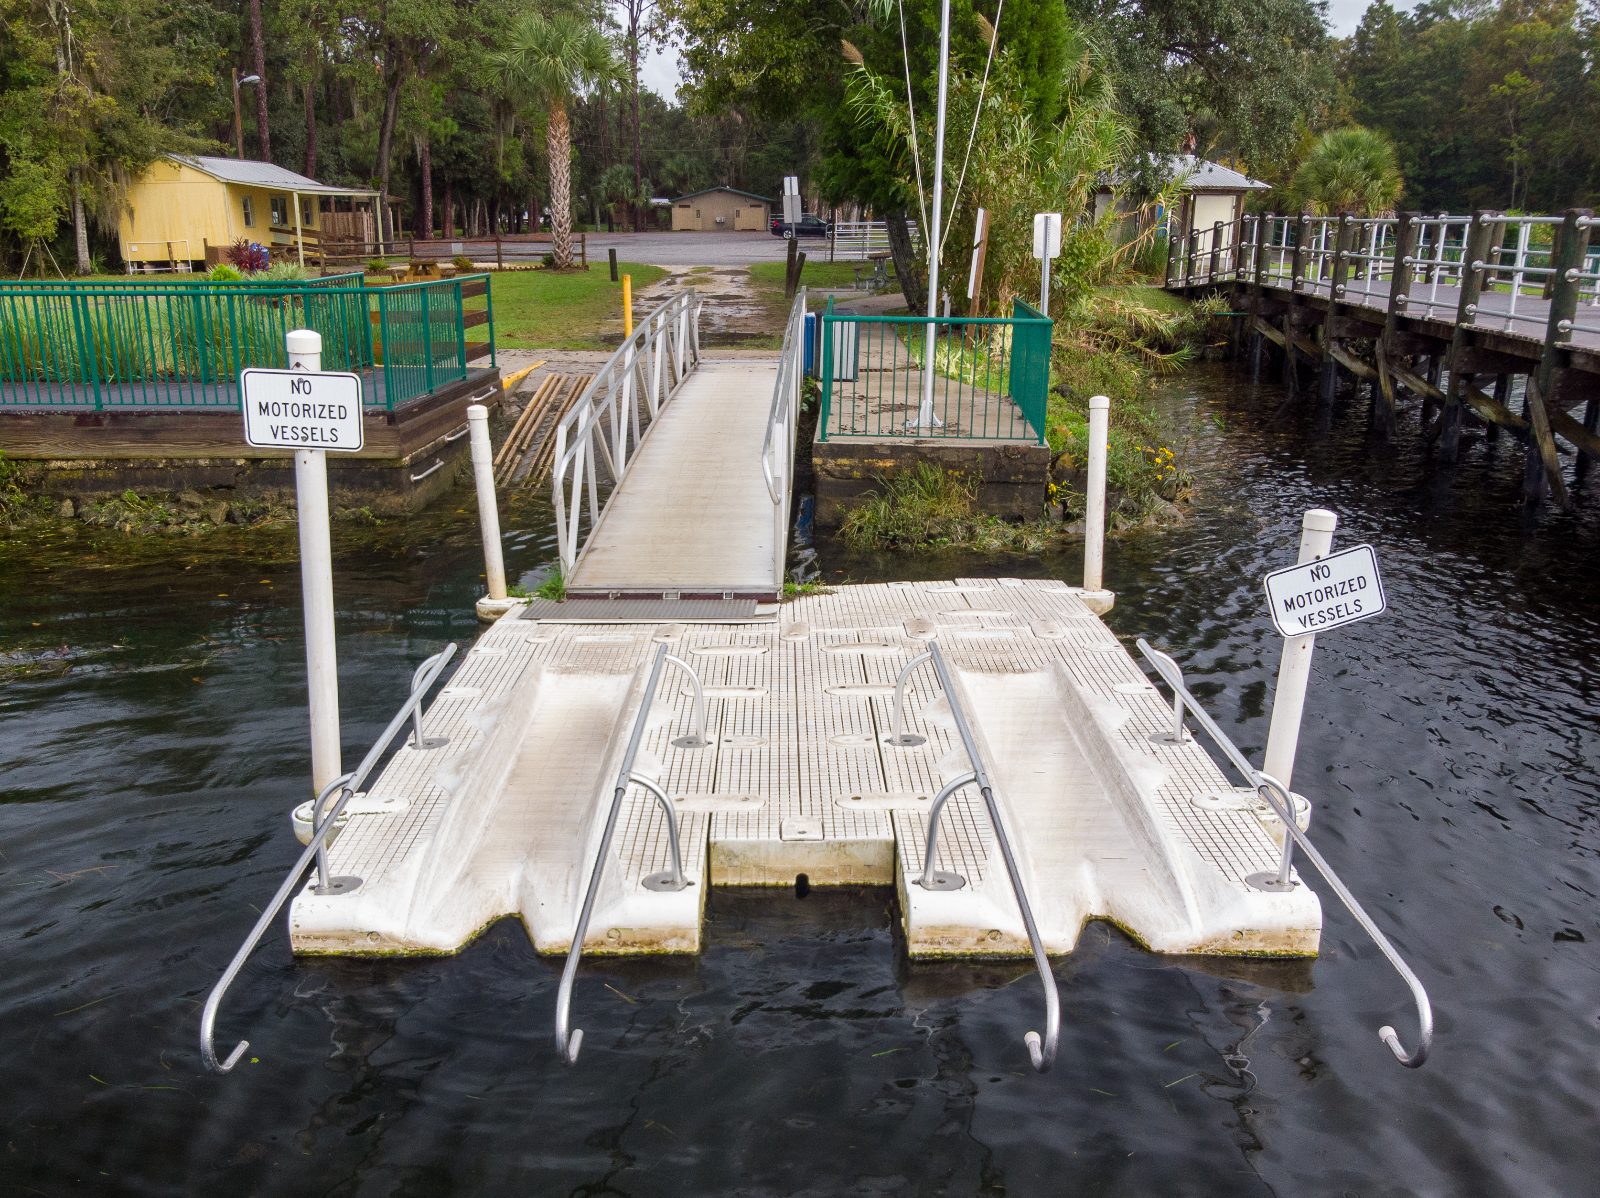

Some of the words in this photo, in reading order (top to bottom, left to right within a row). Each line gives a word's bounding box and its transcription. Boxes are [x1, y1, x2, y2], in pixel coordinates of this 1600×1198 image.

[291, 380, 312, 395] NO
[258, 401, 347, 420] MOTORIZED
[270, 425, 339, 443] VESSELS
[1310, 564, 1331, 582] NO
[1283, 575, 1367, 612] MOTORIZED
[1298, 599, 1363, 628] VESSELS
